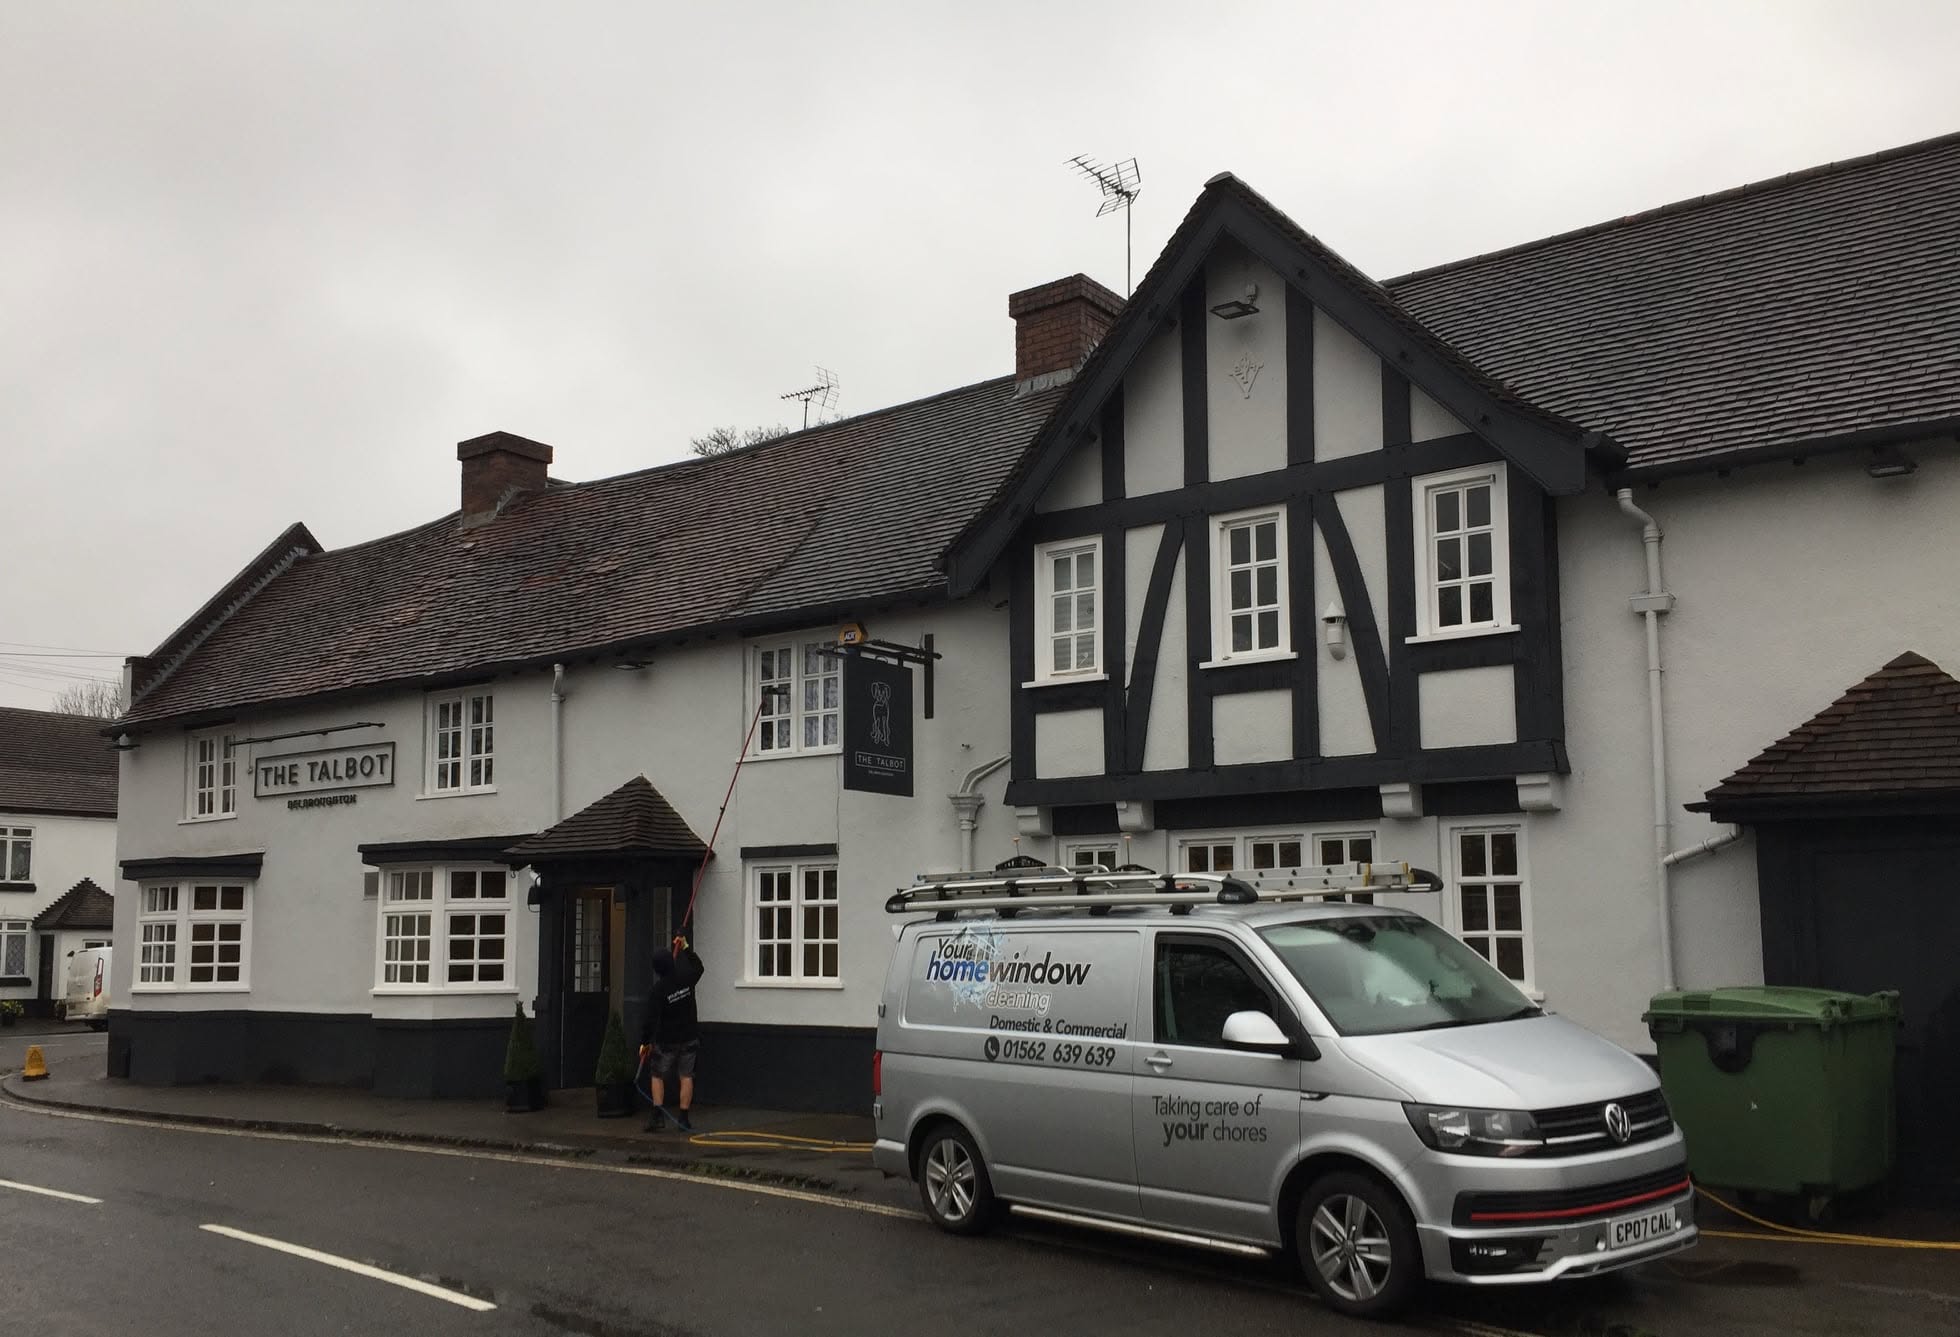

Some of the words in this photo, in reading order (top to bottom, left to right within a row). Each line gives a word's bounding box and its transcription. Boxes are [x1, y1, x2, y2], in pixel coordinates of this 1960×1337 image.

[261, 763, 299, 787] THE
[307, 753, 389, 783] TALBOT
[858, 754, 873, 765] THE
[876, 757, 904, 769] TALBOT
[936, 937, 973, 961] Your
[985, 986, 1052, 1016] cleaning
[990, 1015, 1040, 1033] Domestic
[1043, 1018, 1052, 1034] &
[1055, 1019, 1127, 1040] Commercial
[1003, 1039, 1046, 1061] 01562
[1053, 1043, 1083, 1064] 639
[1084, 1045, 1116, 1067] 639
[1152, 1094, 1201, 1122] Taking
[1205, 1100, 1239, 1116] care
[1243, 1093, 1263, 1116] of
[1163, 1122, 1209, 1147] your
[1213, 1120, 1267, 1142] chores
[1650, 1212, 1671, 1235] CAL
